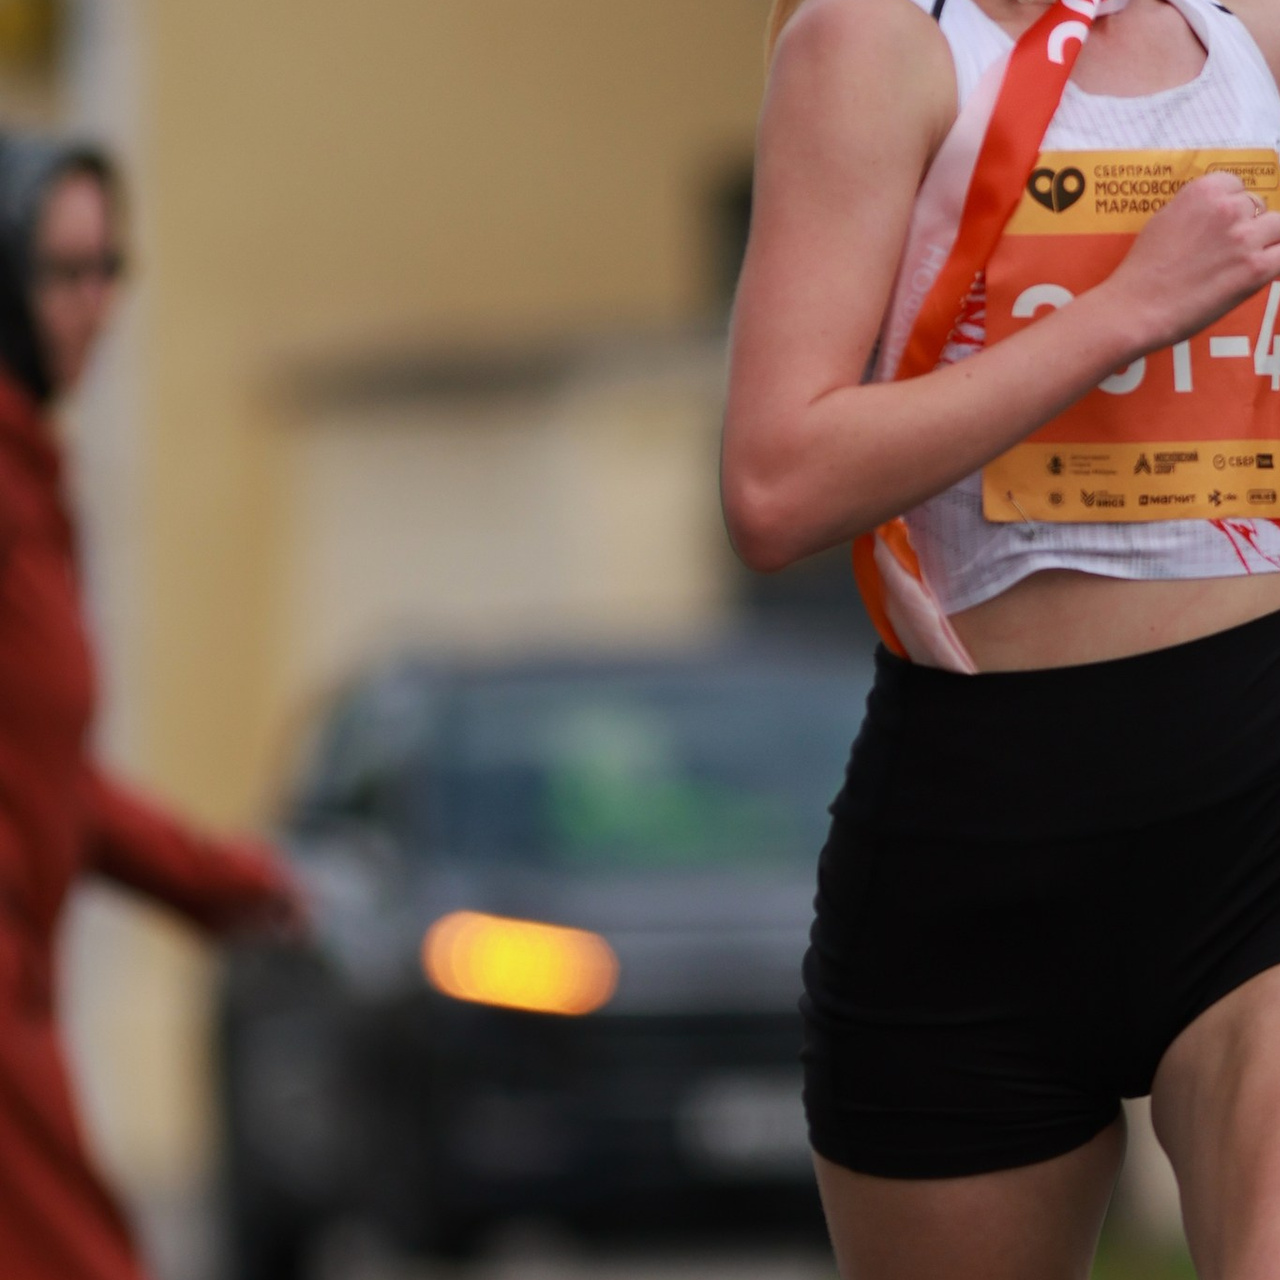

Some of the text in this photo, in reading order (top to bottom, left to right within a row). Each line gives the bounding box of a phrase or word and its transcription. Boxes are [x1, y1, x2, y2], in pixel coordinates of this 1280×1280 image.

[1093, 163, 1172, 177] СБЕРПРАЙМ
[1095, 198, 1166, 214] МАРАФО
[1228, 455, 1254, 467] СБЕР
